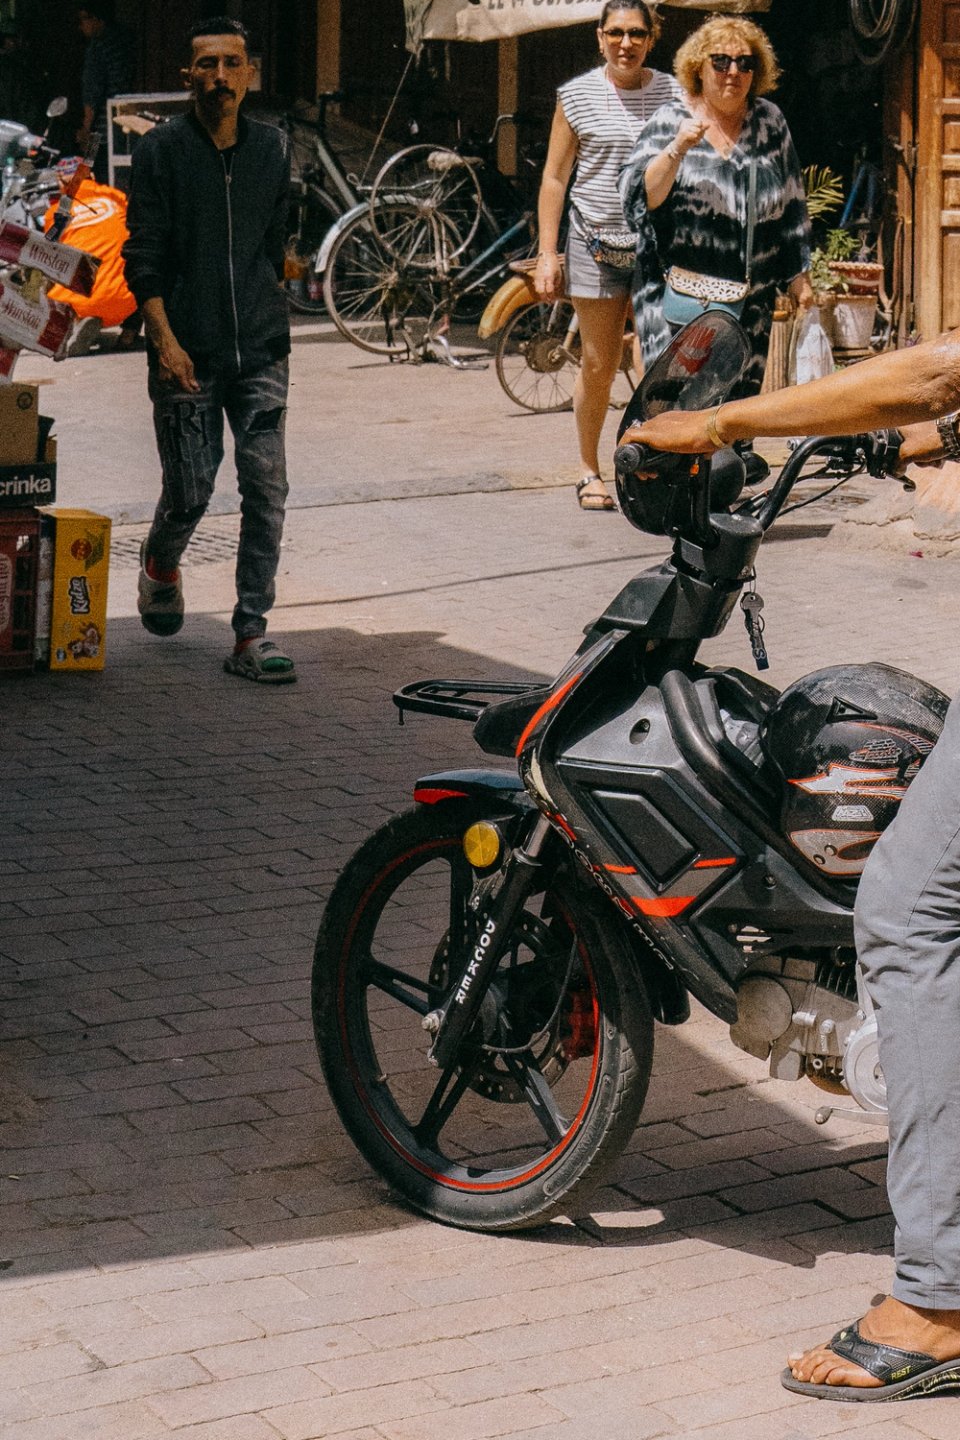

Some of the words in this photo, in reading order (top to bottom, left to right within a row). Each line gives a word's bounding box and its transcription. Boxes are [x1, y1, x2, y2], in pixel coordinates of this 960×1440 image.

[28, 243, 70, 275] Winston
[4, 297, 42, 330] Winston
[455, 919, 496, 1005] DOCKER
[891, 1364, 912, 1381] REST
